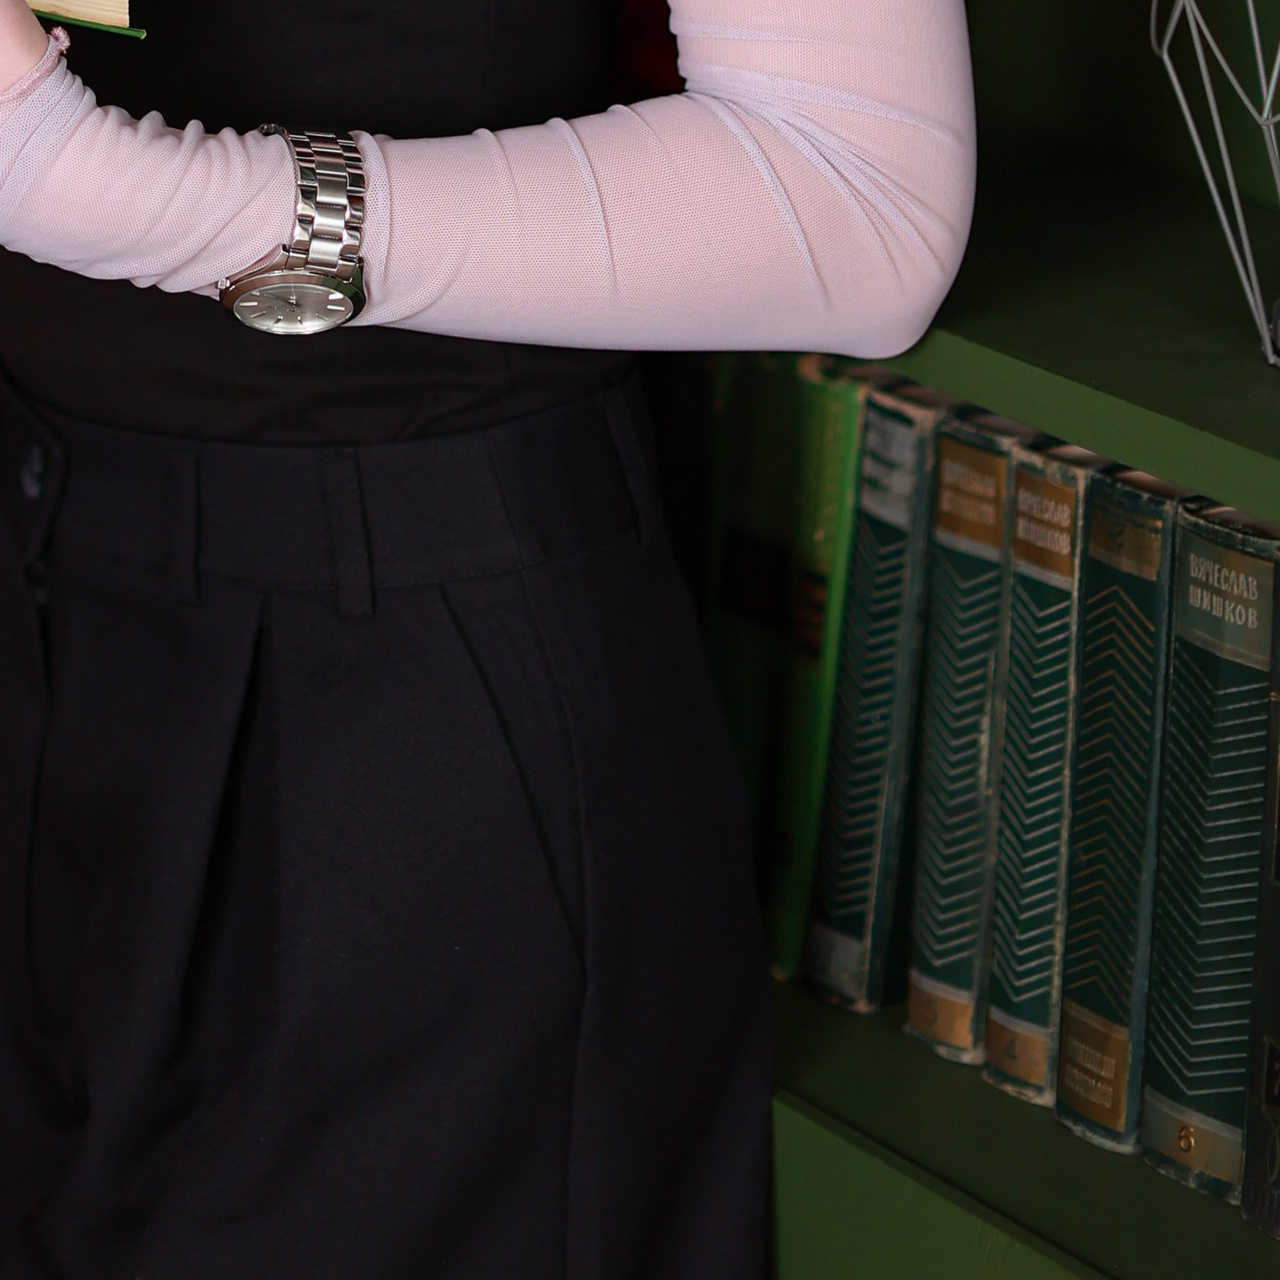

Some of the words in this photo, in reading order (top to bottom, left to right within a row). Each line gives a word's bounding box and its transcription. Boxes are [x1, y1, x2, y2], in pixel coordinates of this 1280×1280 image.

[1188, 552, 1259, 601] ВЯЧЕСЛАВ
[1188, 584, 1260, 629] ШИШКОВ
[1003, 1037, 1017, 1061] 4
[1178, 1125, 1196, 1154] 6
